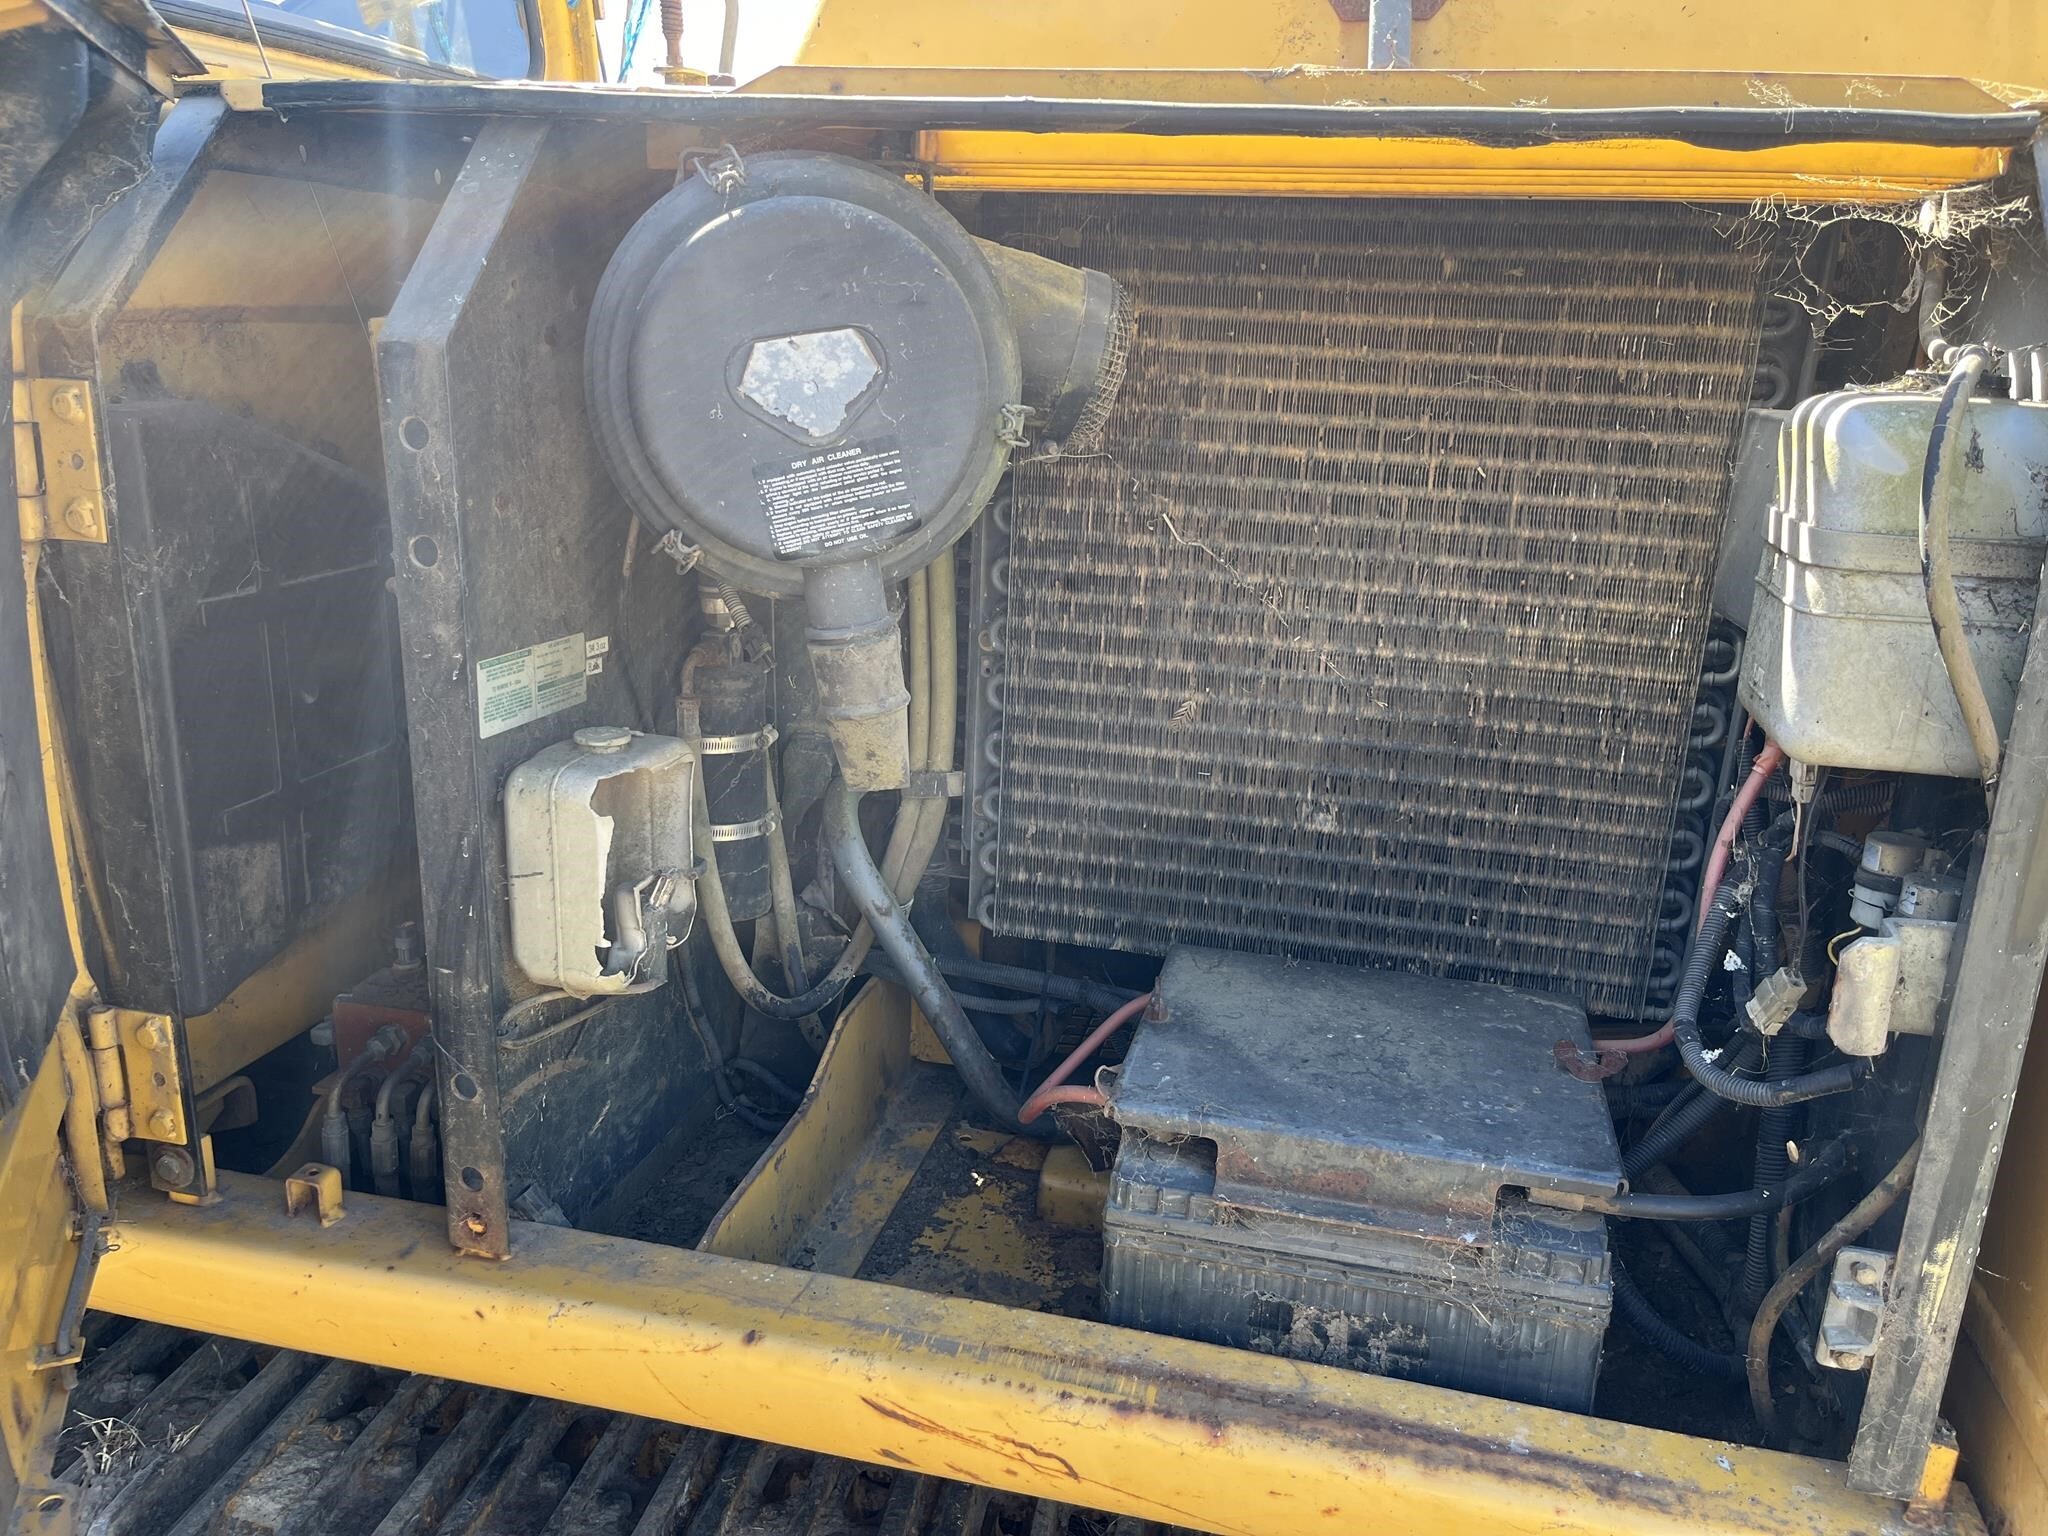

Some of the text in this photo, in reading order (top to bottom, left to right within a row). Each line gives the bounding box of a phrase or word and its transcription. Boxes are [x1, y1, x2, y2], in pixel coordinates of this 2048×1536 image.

[791, 447, 862, 470] DRY AIR CLEANER
[833, 538, 845, 546] NOT
